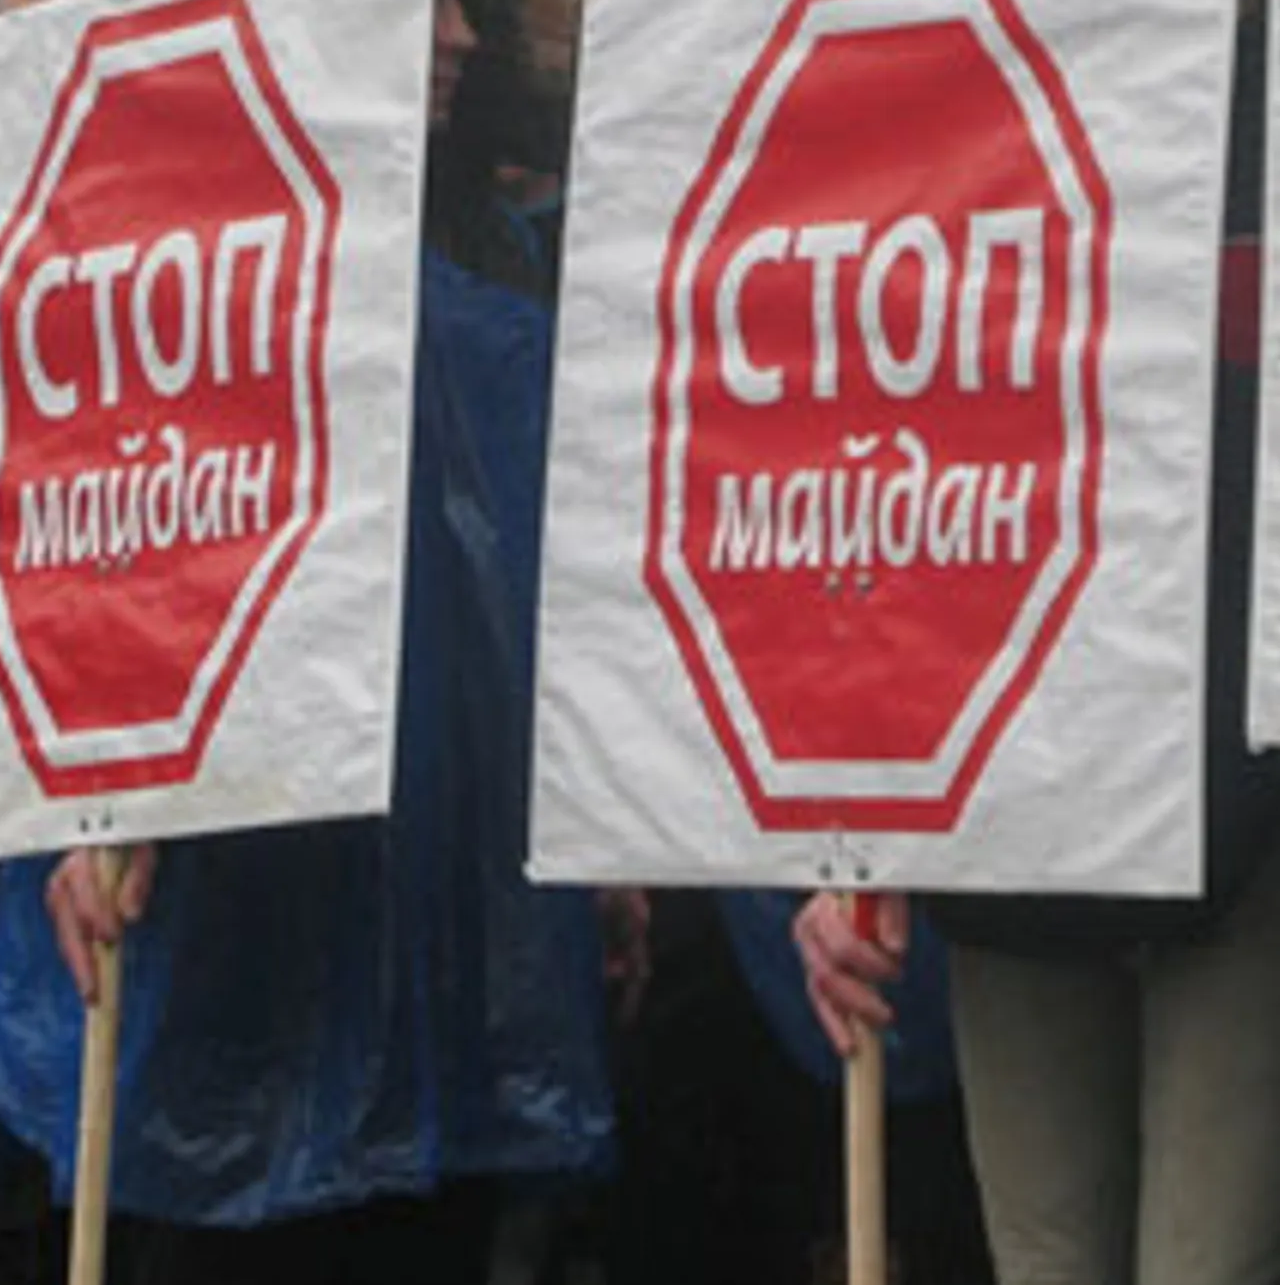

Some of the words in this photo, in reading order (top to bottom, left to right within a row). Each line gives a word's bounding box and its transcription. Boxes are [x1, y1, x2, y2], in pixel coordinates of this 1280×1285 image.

[14, 213, 288, 421] СТОП
[714, 207, 1045, 405] СТОП
[13, 424, 277, 574] майдан
[709, 428, 1038, 572] майдан
